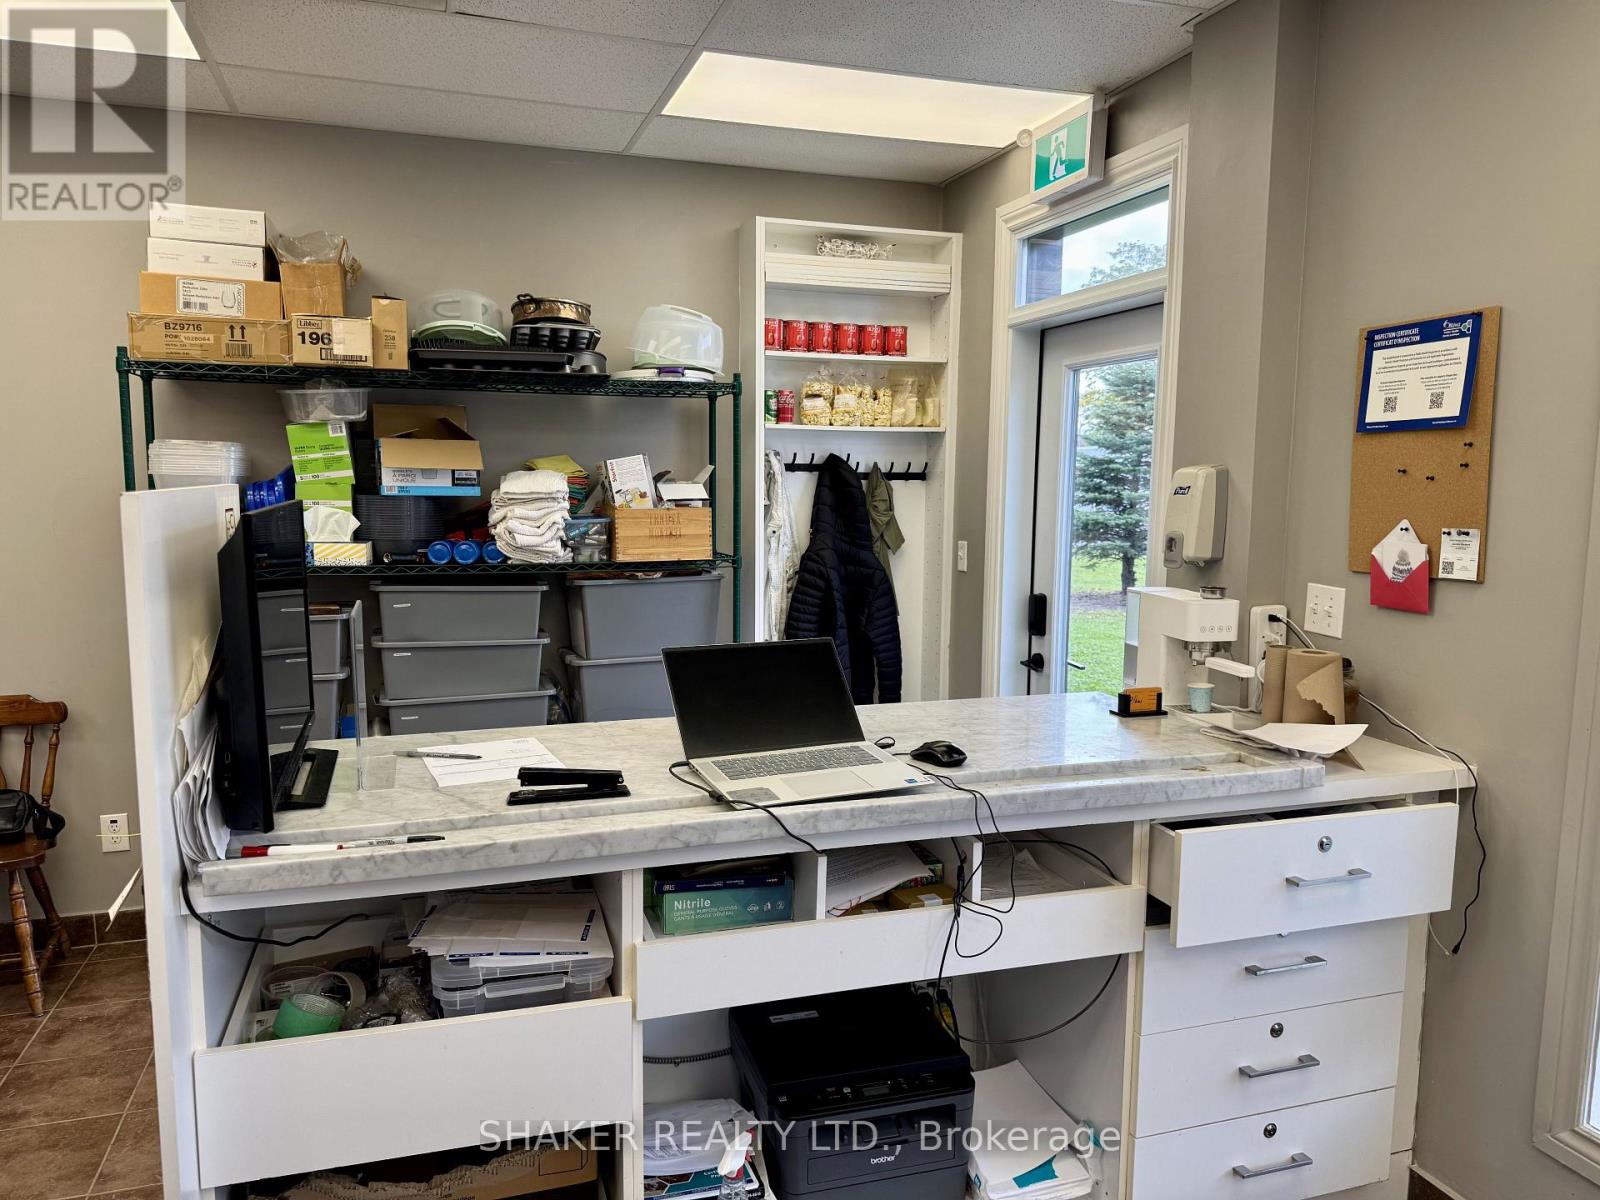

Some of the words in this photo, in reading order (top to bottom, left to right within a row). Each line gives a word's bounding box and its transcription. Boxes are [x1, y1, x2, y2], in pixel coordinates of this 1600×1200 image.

[164, 322, 202, 332] BZ9716
[1374, 332, 1396, 341] INSPECTION
[1396, 327, 1420, 337] CERTIFICATE
[1373, 339, 1394, 348] CERTIFICAT
[674, 899, 711, 911] Nitrile
[870, 1155, 896, 1165] brother
